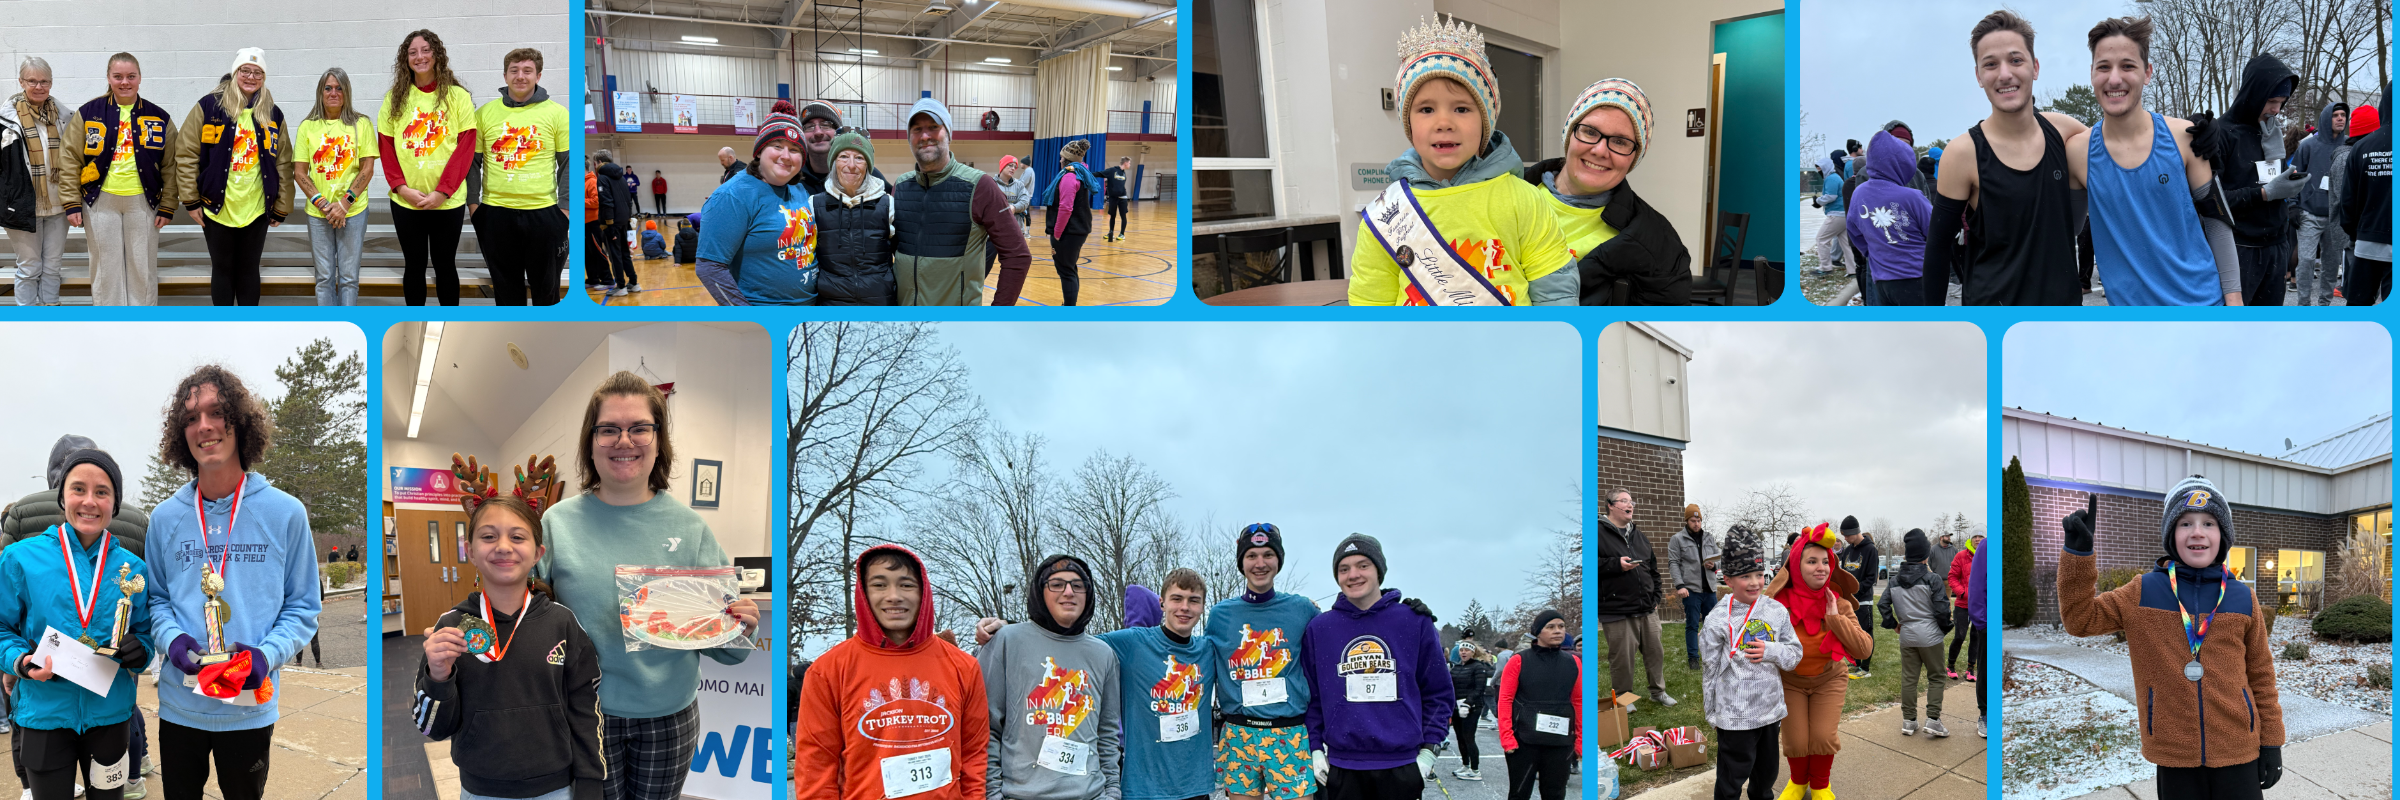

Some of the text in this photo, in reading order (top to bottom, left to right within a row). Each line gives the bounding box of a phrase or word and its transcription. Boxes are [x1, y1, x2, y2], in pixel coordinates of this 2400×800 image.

[1357, 168, 1387, 176] COMPLIM
[1414, 247, 1455, 286] Little
[2183, 489, 2211, 508] B
[231, 543, 269, 553] COUNTRY
[207, 553, 266, 562] TRAK & FIELD
[1228, 656, 1256, 669] IN MY
[1350, 654, 1382, 663] BRYAN
[1341, 659, 1391, 672] GOLDEN BEARS
[734, 682, 764, 697] MAI
[1150, 687, 1180, 700] IN MY
[1261, 688, 1267, 698] 4
[1365, 684, 1376, 694] 87
[1025, 697, 1060, 710] IN MY
[866, 714, 948, 731] TURKEY TROT
[1176, 722, 1189, 733] 336
[1548, 721, 1560, 729] 232
[1046, 727, 1067, 738] ERA
[690, 724, 772, 784] WE
[1058, 751, 1076, 765] 334
[106, 770, 123, 784] 383
[910, 766, 933, 782] 313
